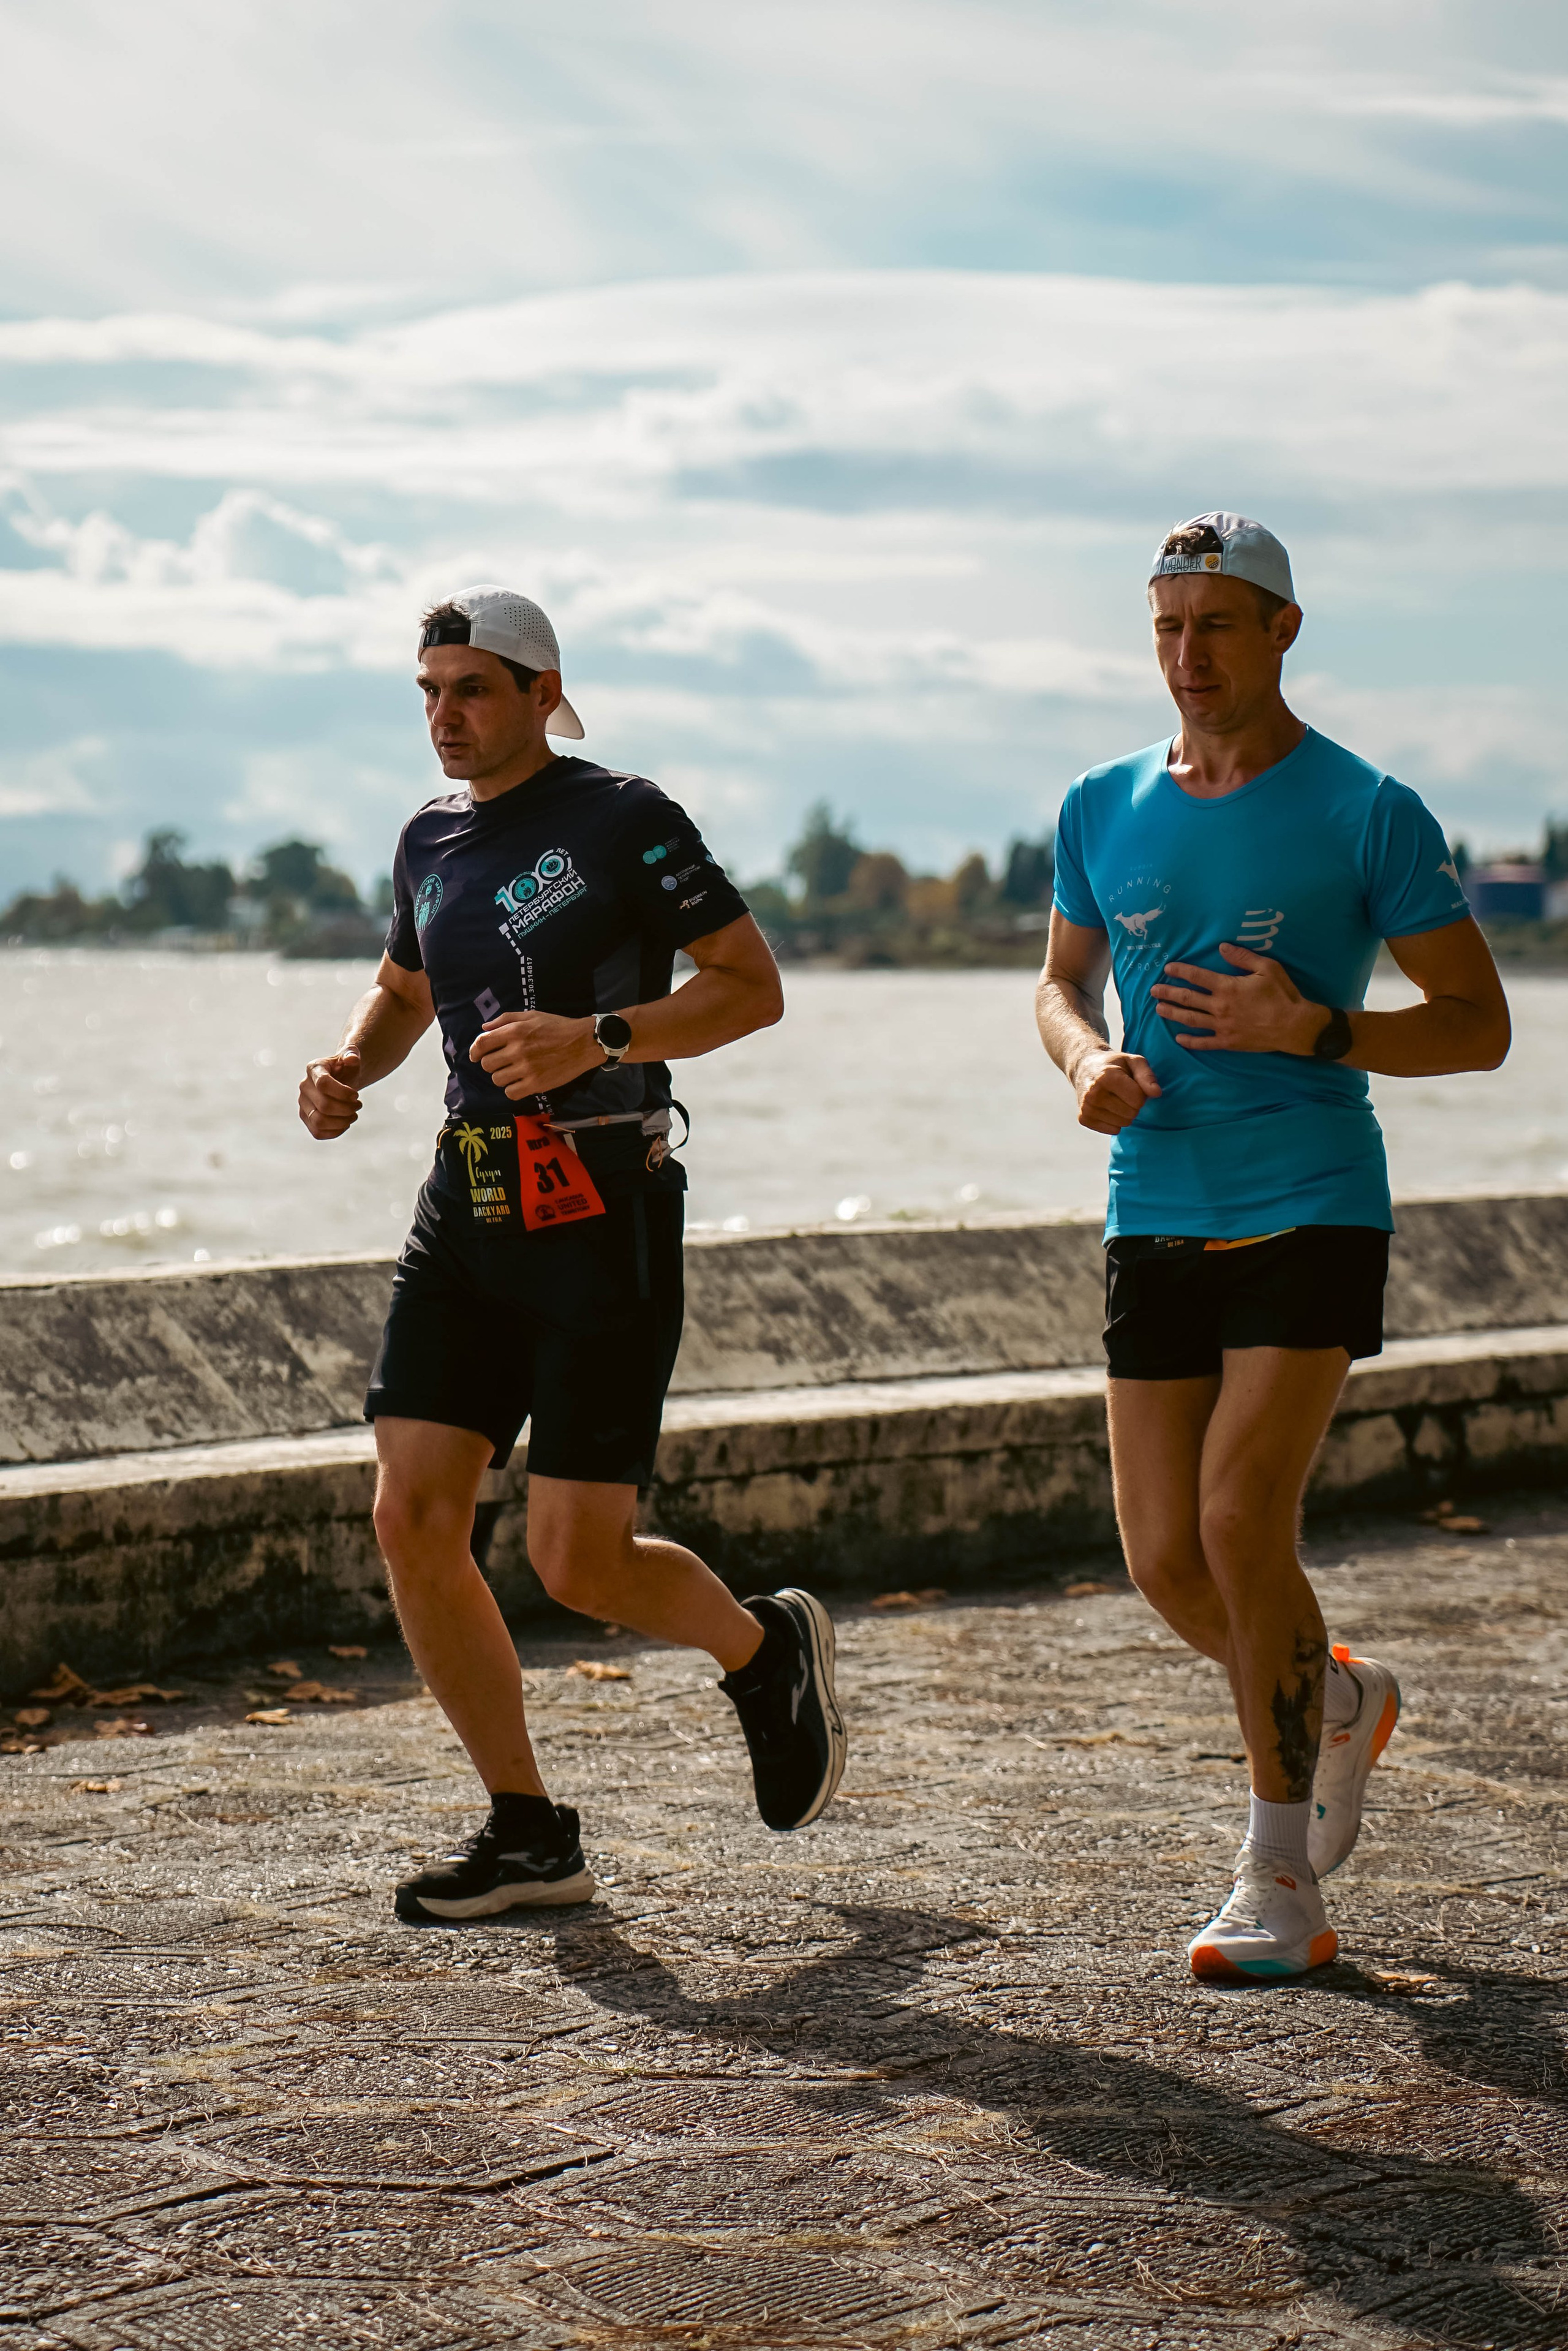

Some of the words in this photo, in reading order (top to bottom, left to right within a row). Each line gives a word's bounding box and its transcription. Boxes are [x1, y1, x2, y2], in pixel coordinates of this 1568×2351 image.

[1161, 555, 1201, 573] WONDER
[508, 868, 578, 924] ПЕТЕРБУРГСКИЙ
[688, 890, 707, 902] PUSHKIN
[1109, 877, 1171, 903] RUNNING
[512, 876, 586, 934] МАРАФОН
[691, 897, 703, 906] RUN
[490, 1126, 512, 1140] 2025
[533, 1157, 570, 1194] 31
[470, 1187, 507, 1203] WORLD
[473, 1204, 511, 1217] BACKYARD
[558, 1198, 588, 1211] UNITED
